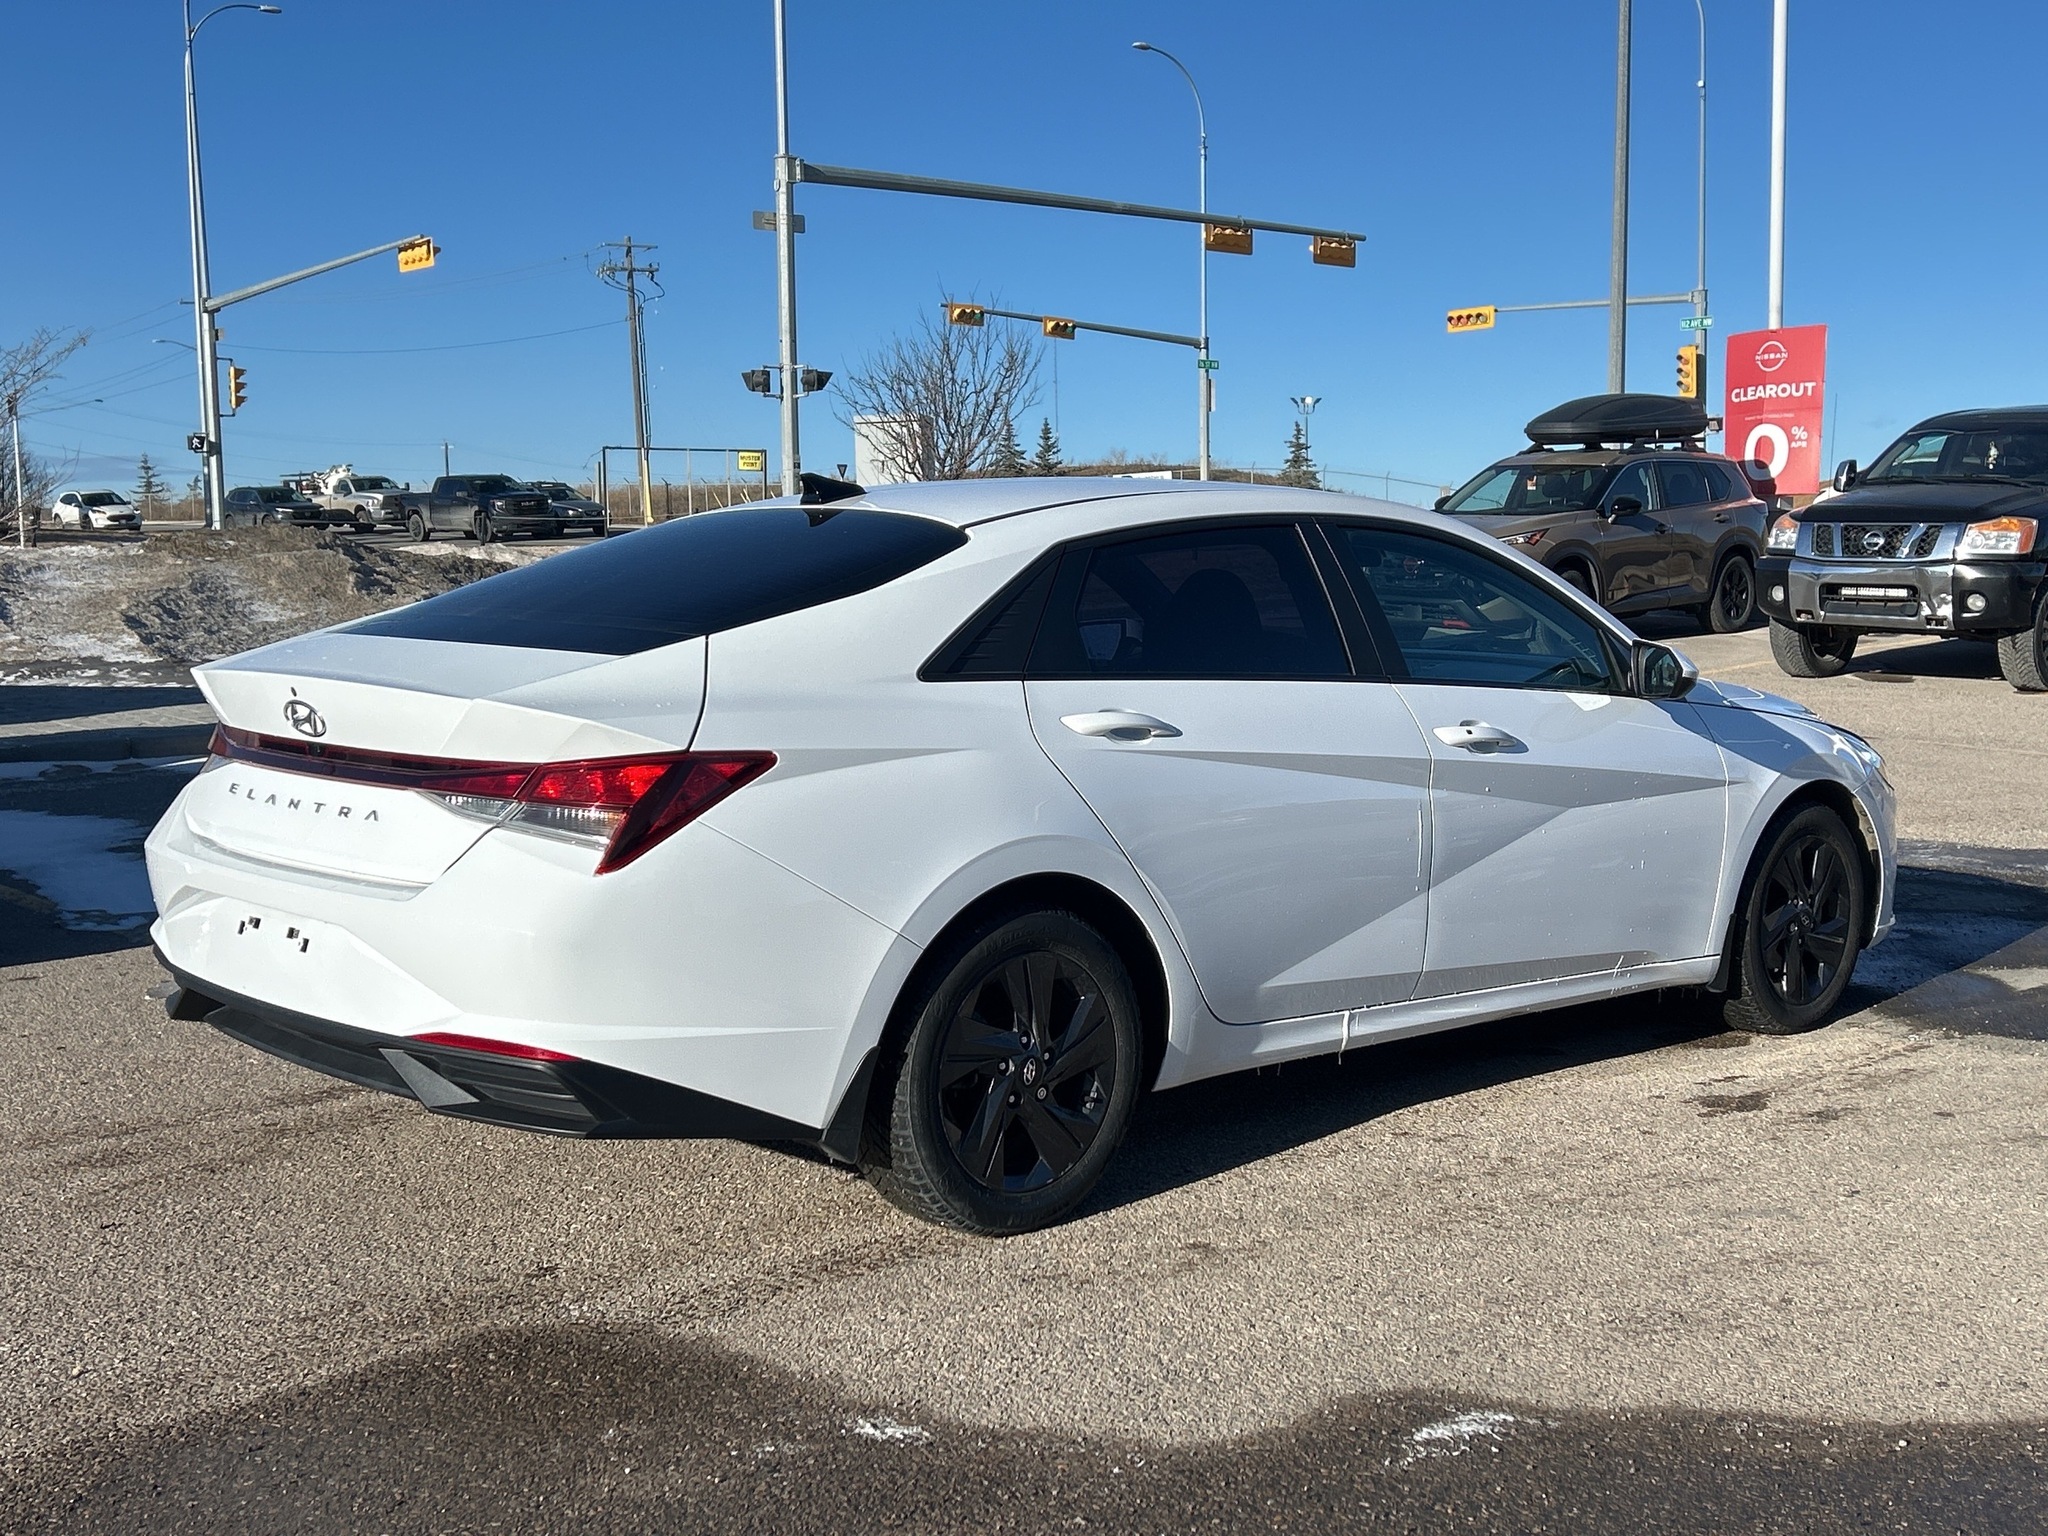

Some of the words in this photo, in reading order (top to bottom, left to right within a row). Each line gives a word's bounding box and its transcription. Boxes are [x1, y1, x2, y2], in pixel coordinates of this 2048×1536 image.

[1690, 318, 1702, 328] AVE
[1702, 318, 1713, 326] NW
[1755, 352, 1788, 361] NISSAN
[1731, 381, 1817, 403] CLEAROUT
[1744, 423, 1789, 480] 0
[228, 782, 380, 822] ELANTRA
